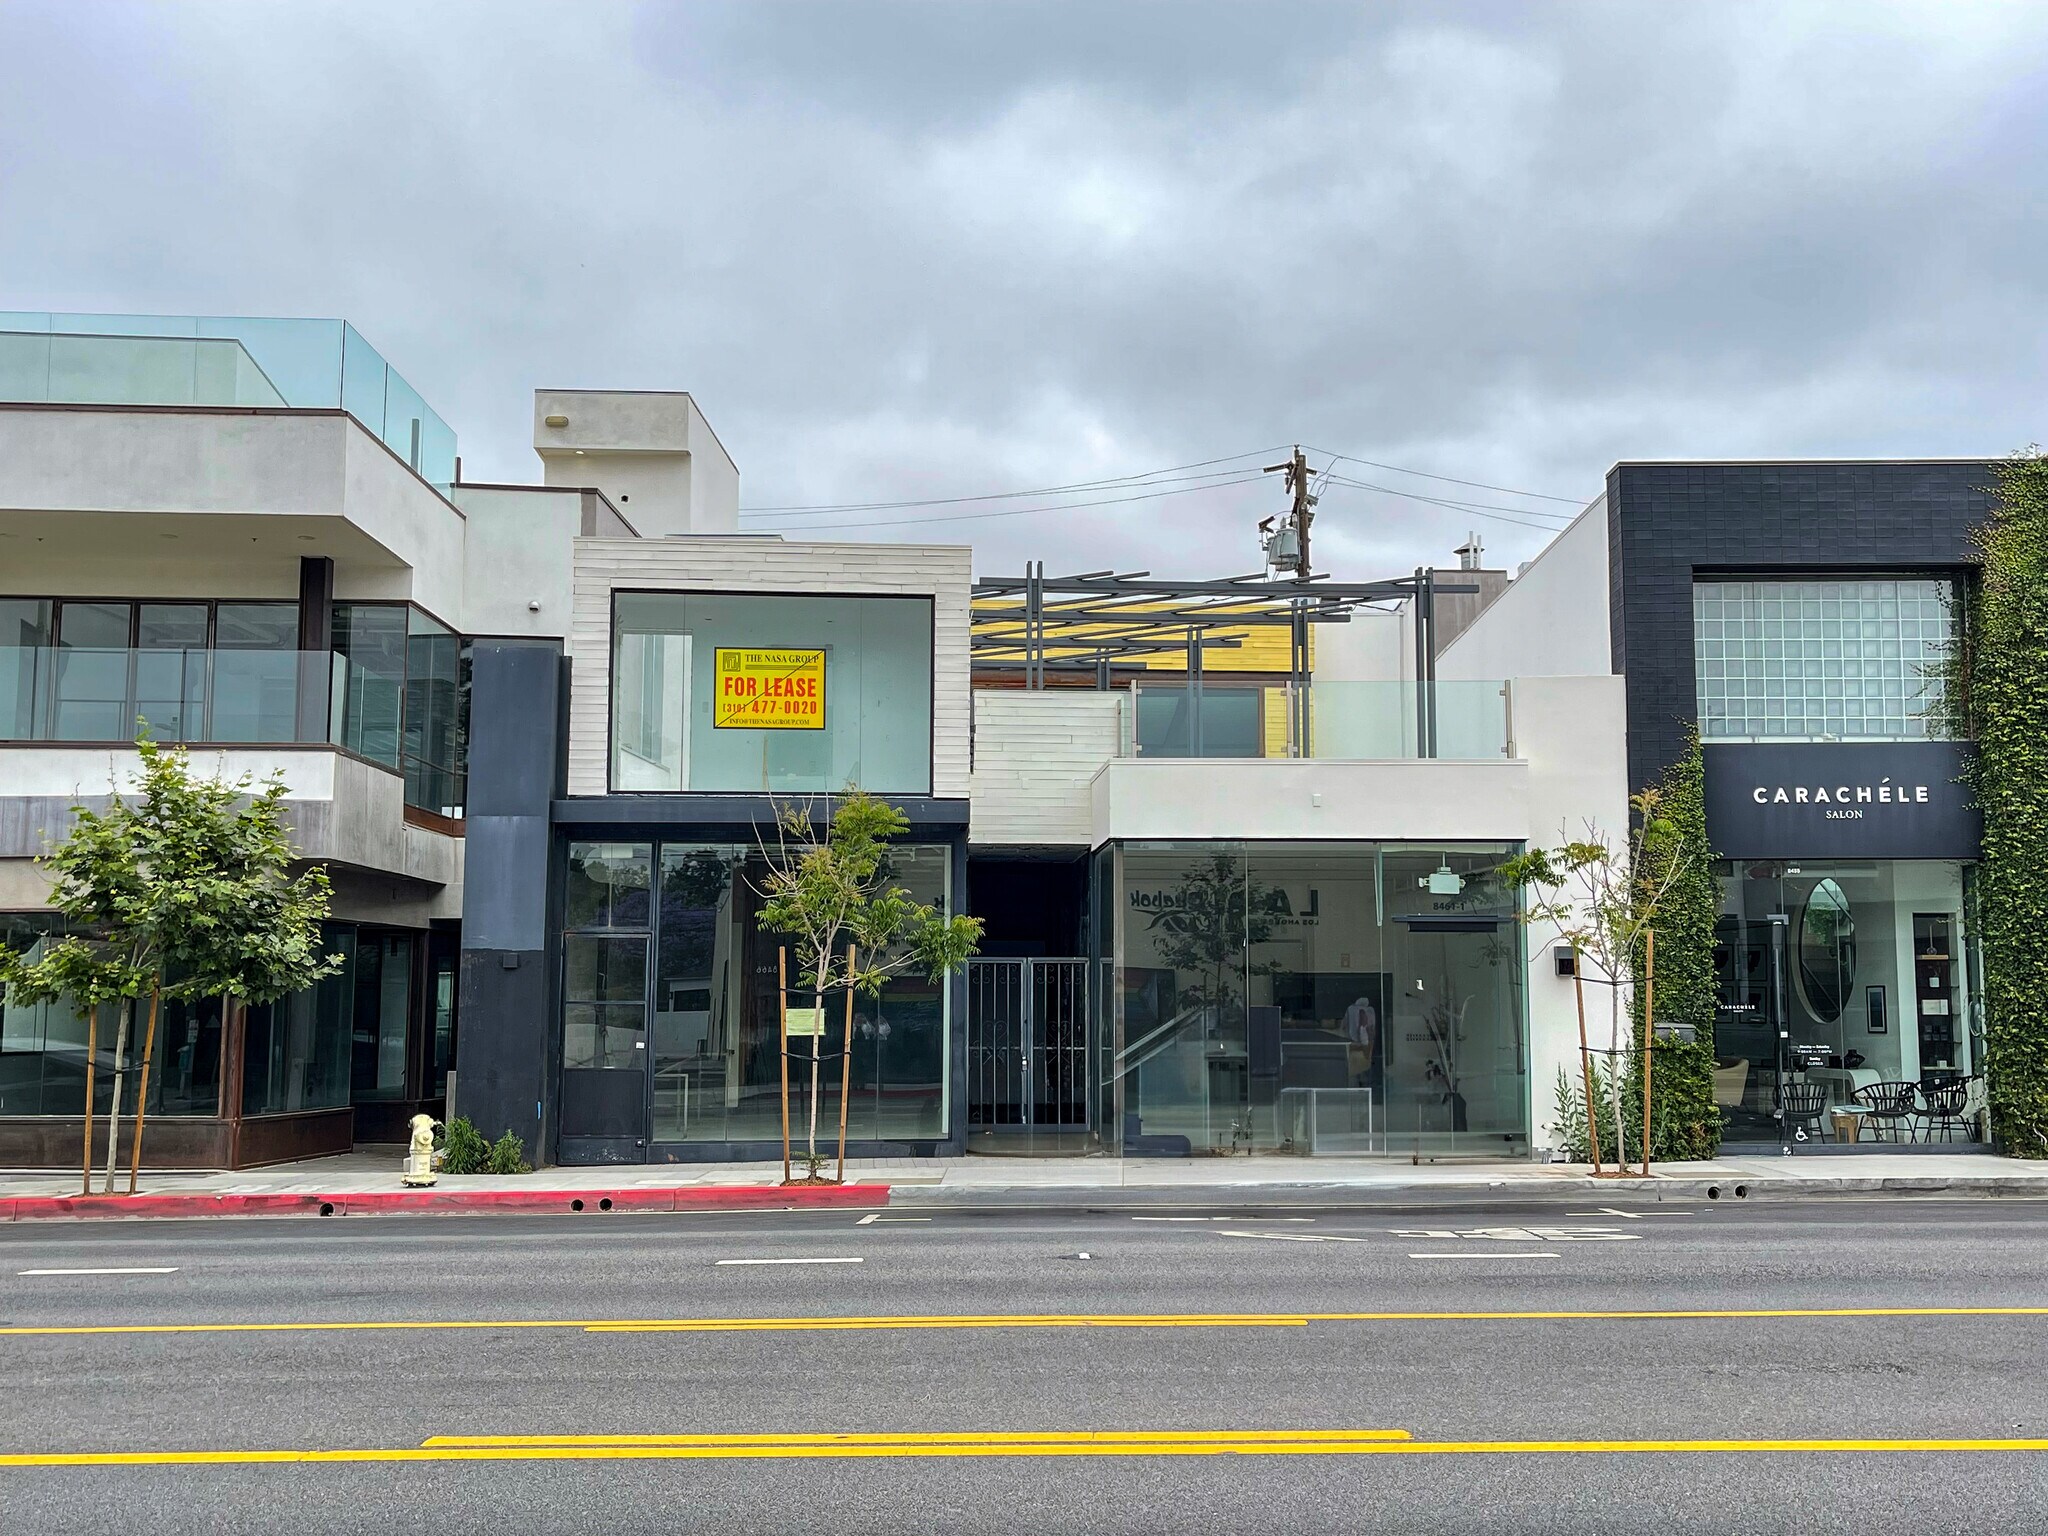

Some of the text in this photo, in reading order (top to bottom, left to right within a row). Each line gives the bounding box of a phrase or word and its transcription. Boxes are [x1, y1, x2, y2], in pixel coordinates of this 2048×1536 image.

[745, 654, 819, 664] THE NASA GROUP
[724, 677, 817, 697] FOR LEASE
[752, 700, 817, 714] 477-0020
[1753, 776, 1929, 804] CARACHÉLE
[1825, 810, 1863, 819] SALON
[1433, 902, 1465, 911] 8461-1
